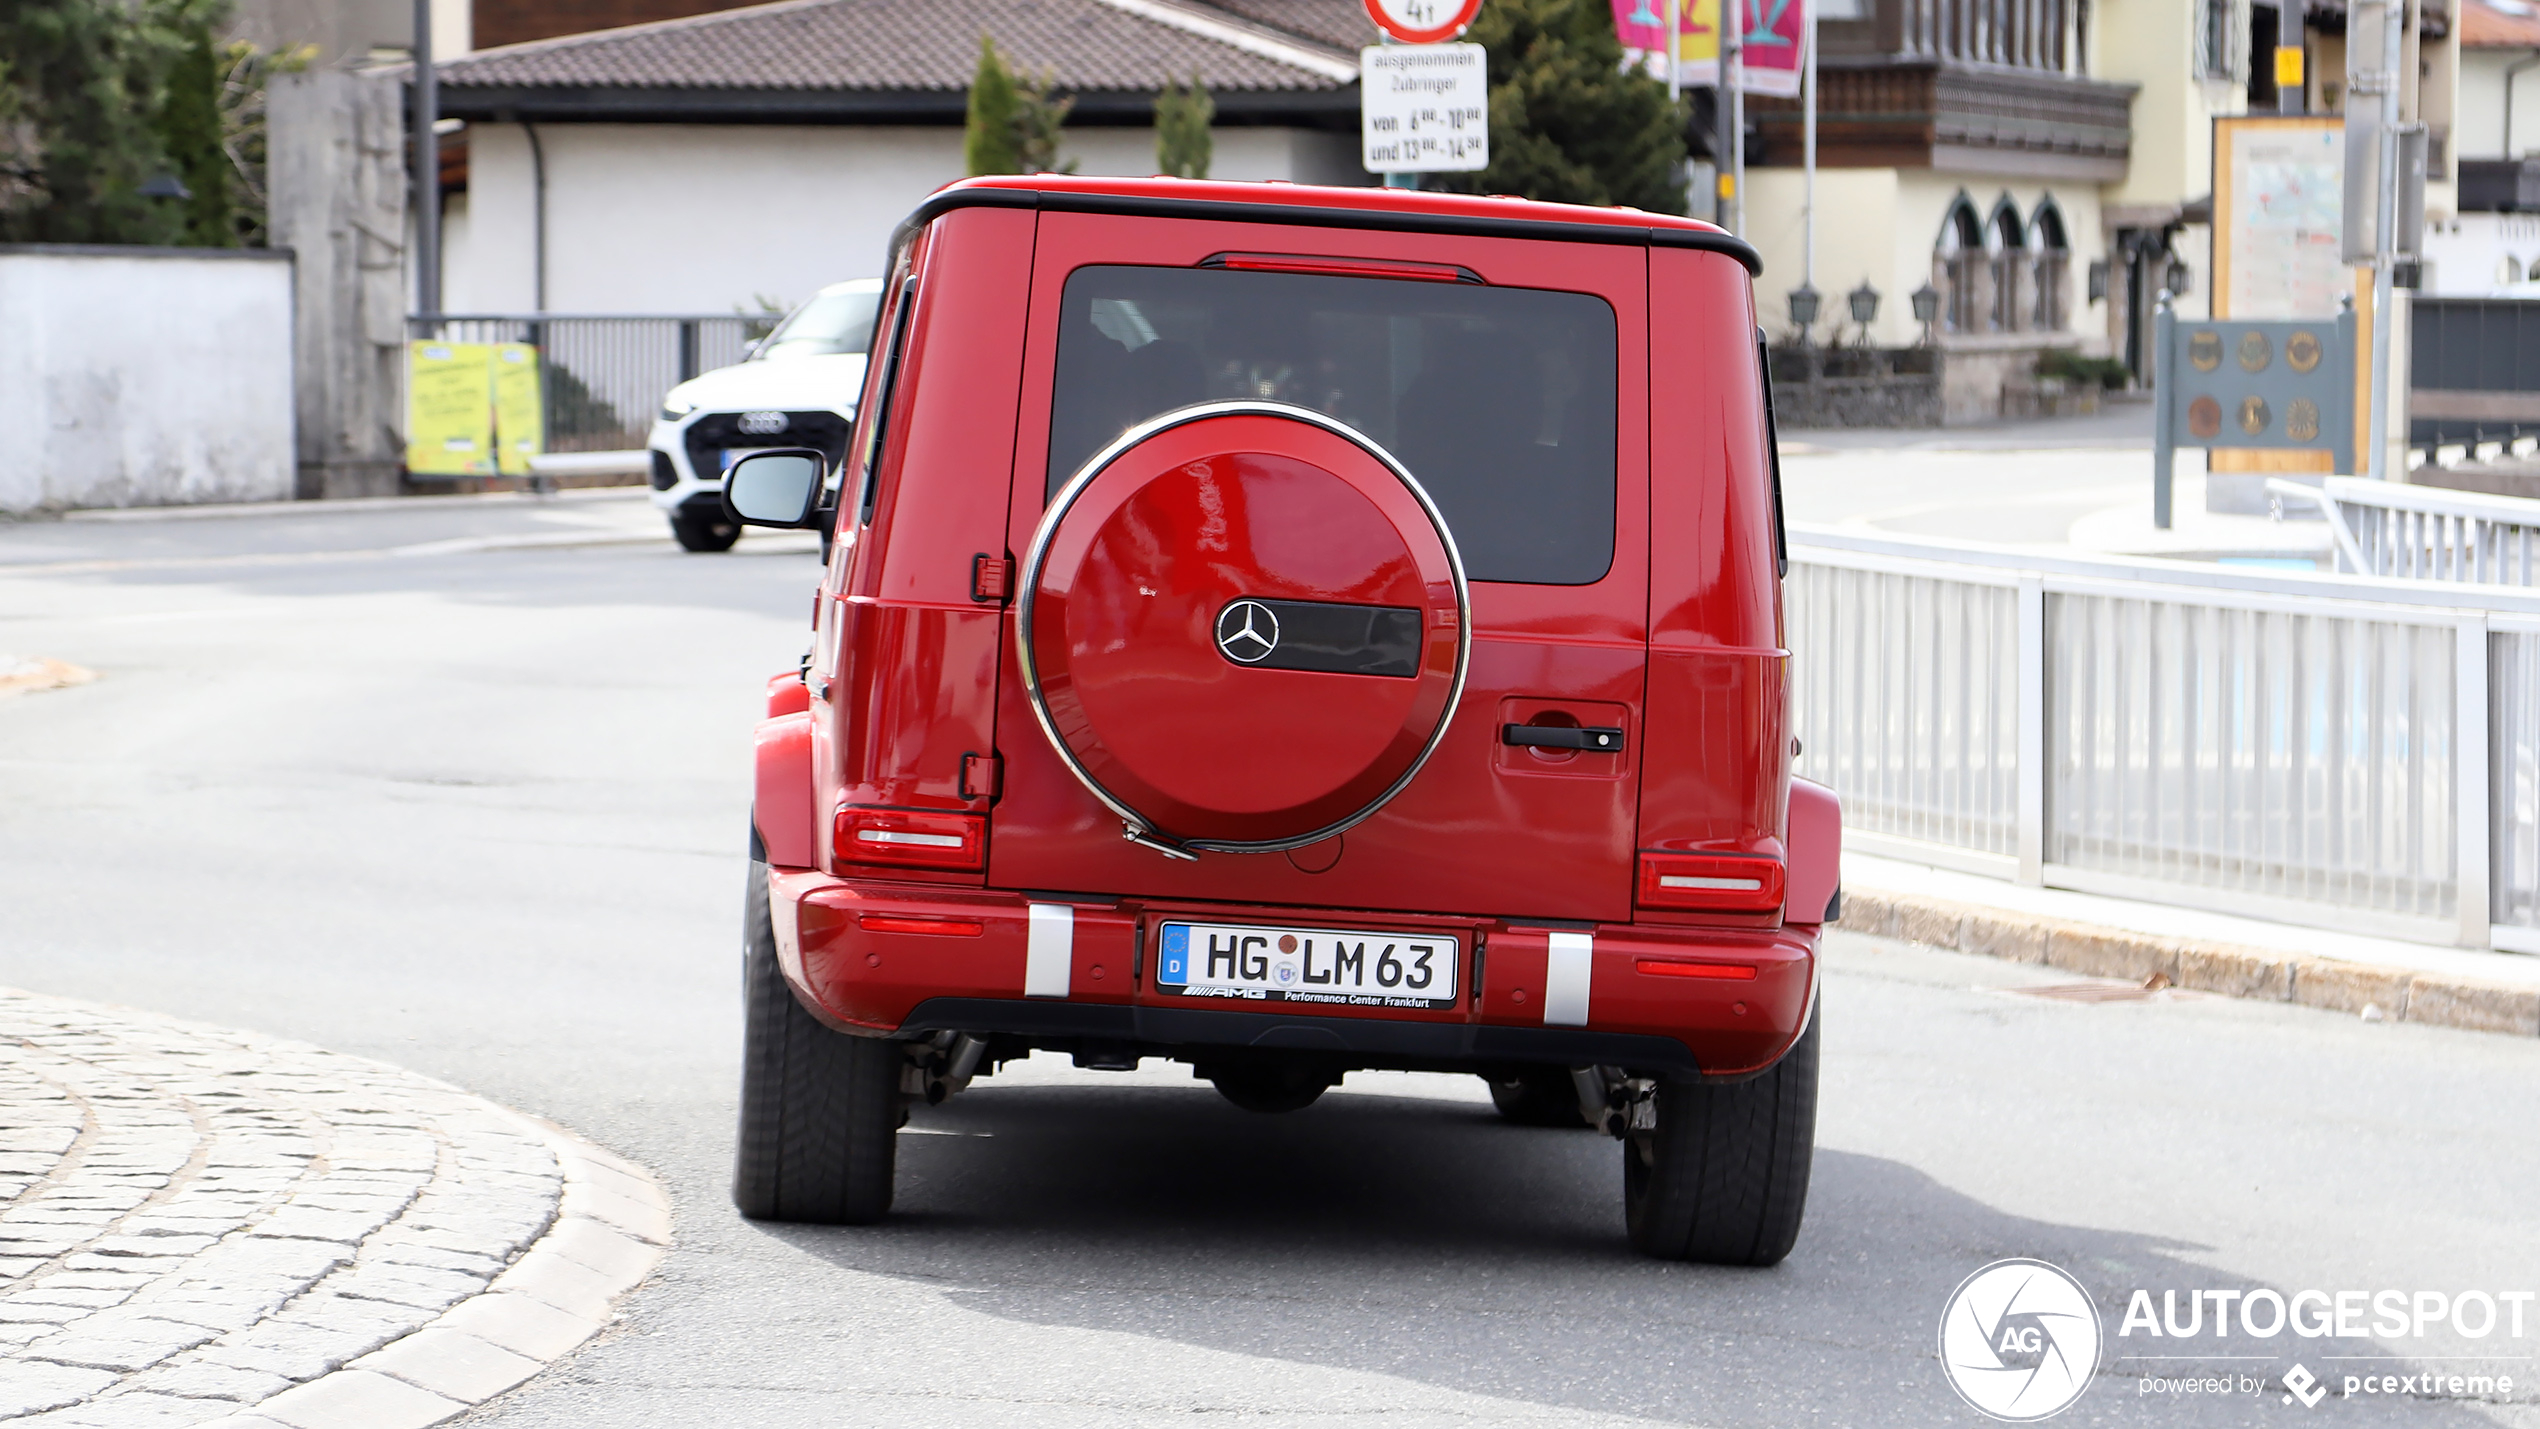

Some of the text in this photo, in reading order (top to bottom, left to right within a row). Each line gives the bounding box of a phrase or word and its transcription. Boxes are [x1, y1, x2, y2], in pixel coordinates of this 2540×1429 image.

[1374, 53, 1475, 70] ausgenommen
[1391, 75, 1457, 94] Zubringer
[1373, 116, 1398, 132] von
[1372, 141, 1399, 161] und
[1168, 959, 1181, 974] D
[1207, 933, 1434, 989] HG LM 63
[1284, 991, 1430, 1008] Performance Center Frankfurt
